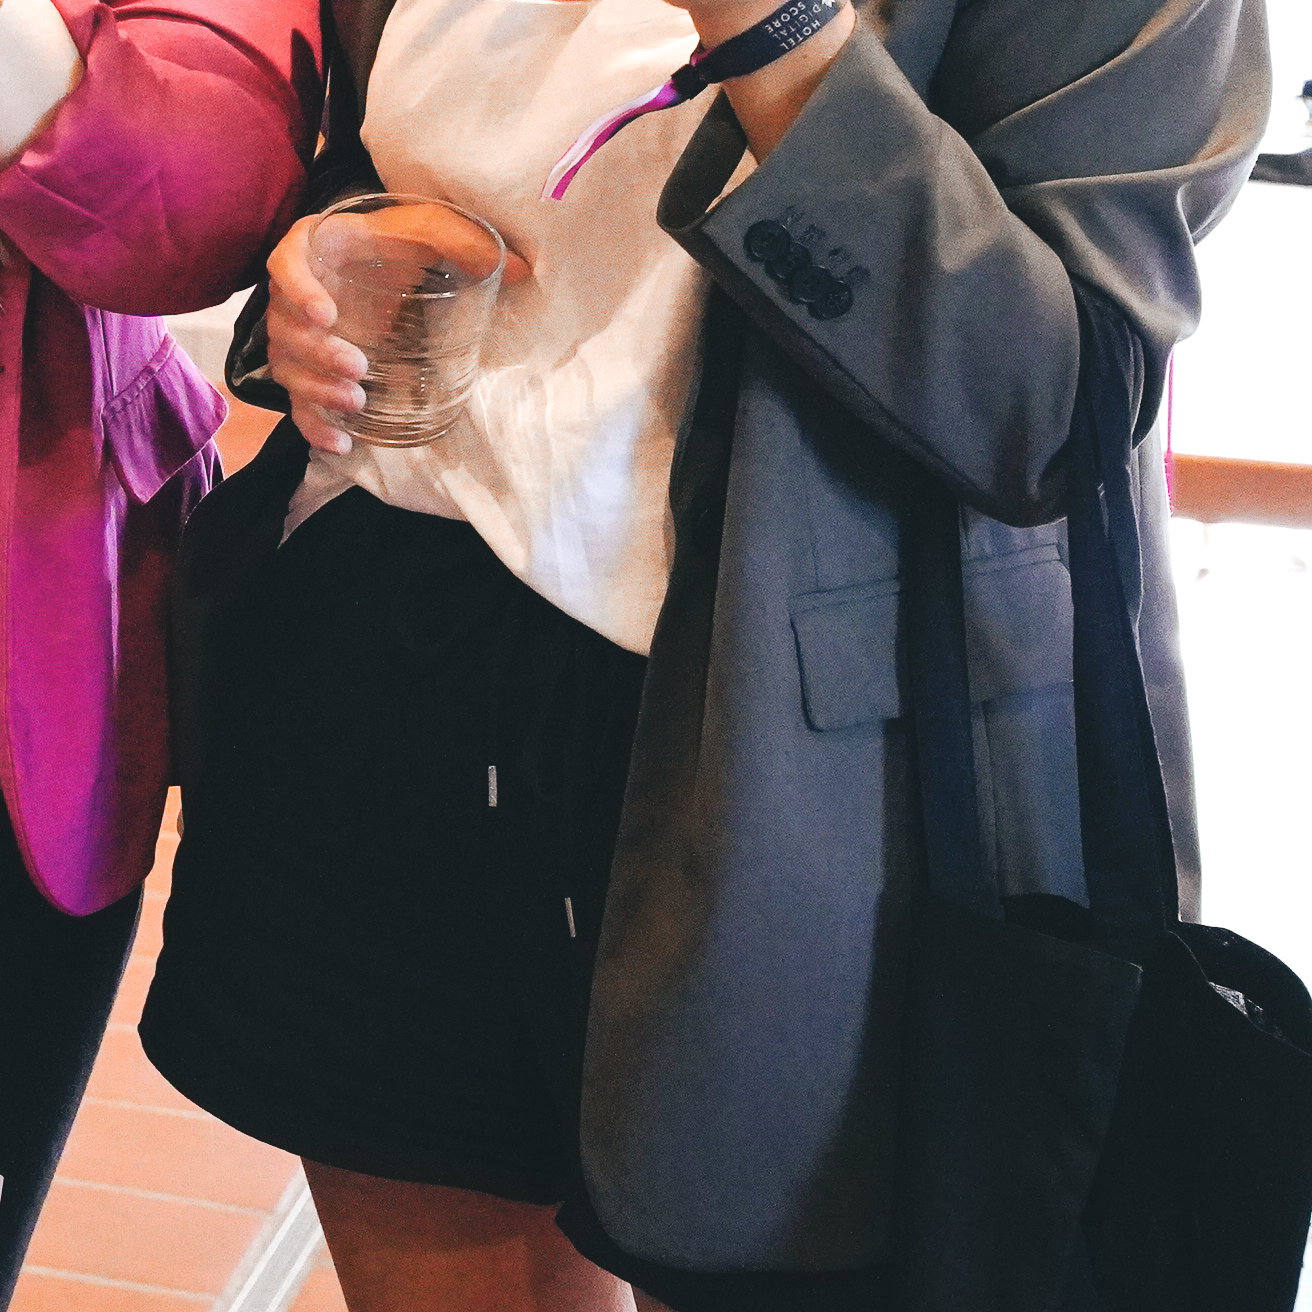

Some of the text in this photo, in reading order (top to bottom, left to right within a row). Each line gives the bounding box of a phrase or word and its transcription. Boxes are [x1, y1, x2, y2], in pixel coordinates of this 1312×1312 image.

[764, 1, 806, 33] SCORE
[772, 1, 822, 40] DIGITAL
[780, 19, 821, 50] HOTEL
